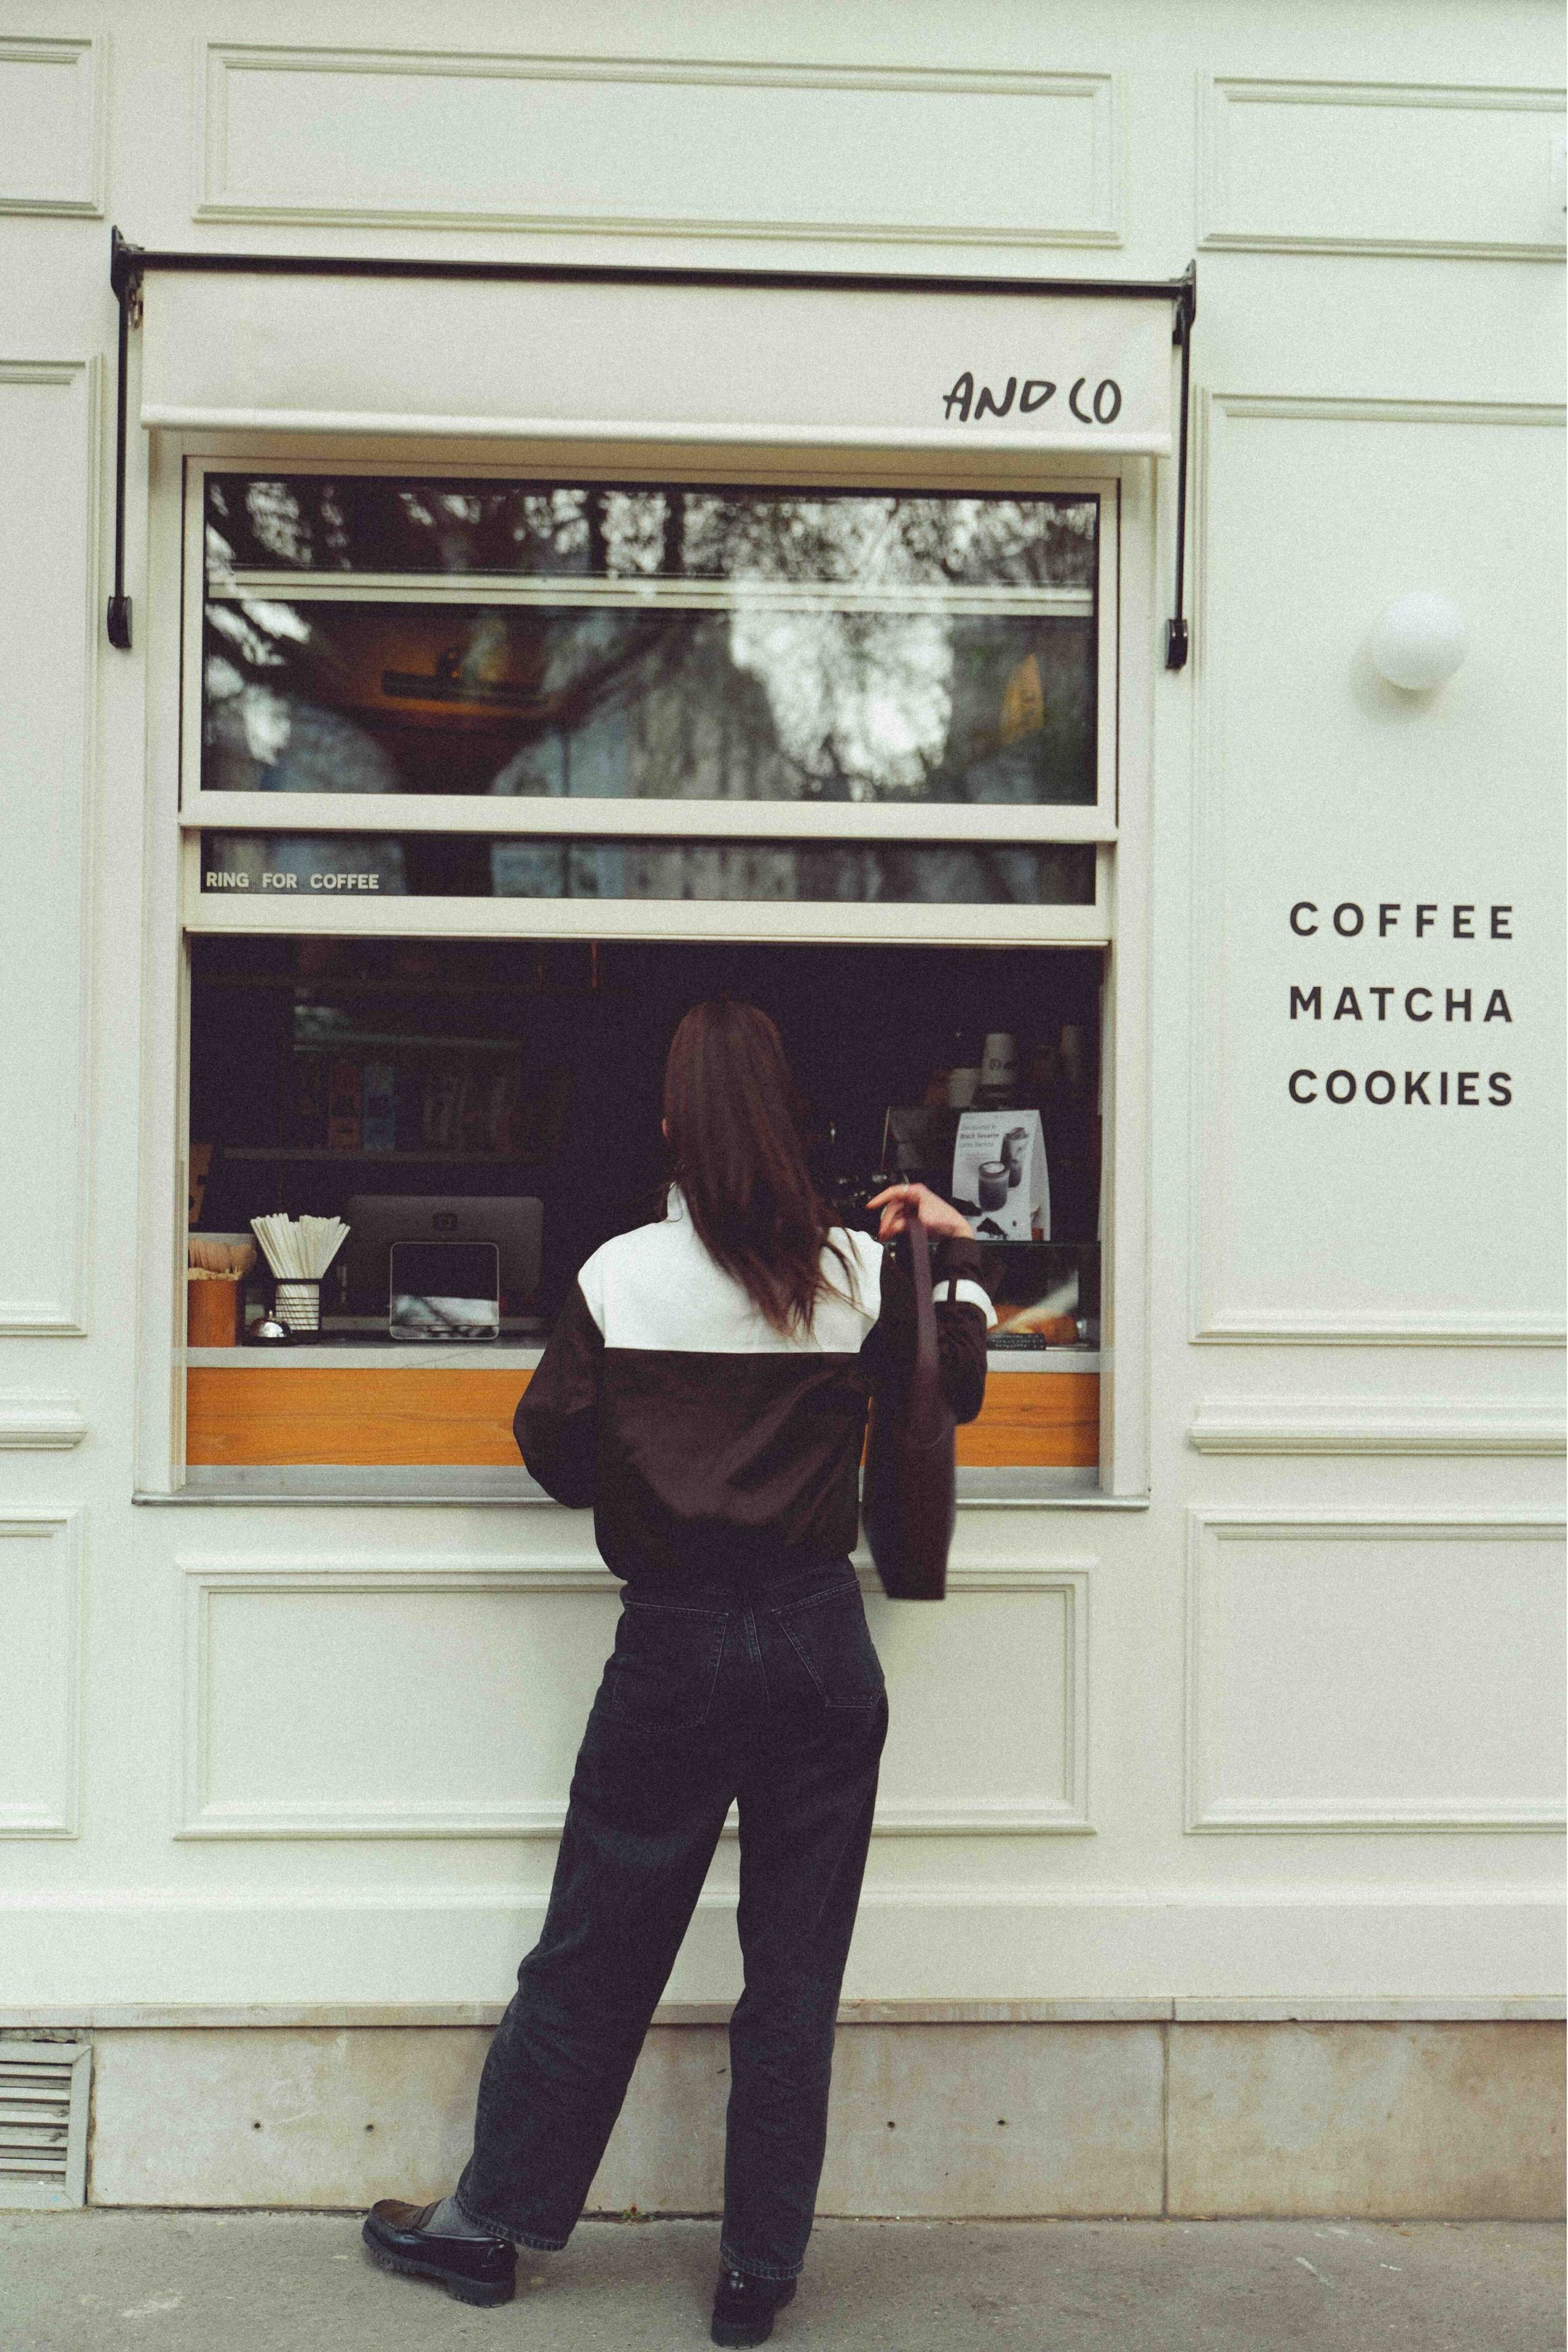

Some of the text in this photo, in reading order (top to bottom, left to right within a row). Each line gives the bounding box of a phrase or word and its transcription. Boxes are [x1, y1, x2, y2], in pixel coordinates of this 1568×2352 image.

[943, 371, 1122, 424] AND CO
[206, 872, 380, 890] RING FOR COFFEE
[1289, 902, 1512, 939] COFFEE
[1290, 985, 1512, 1023] MATCHA
[1288, 1068, 1512, 1106] COOKIES
